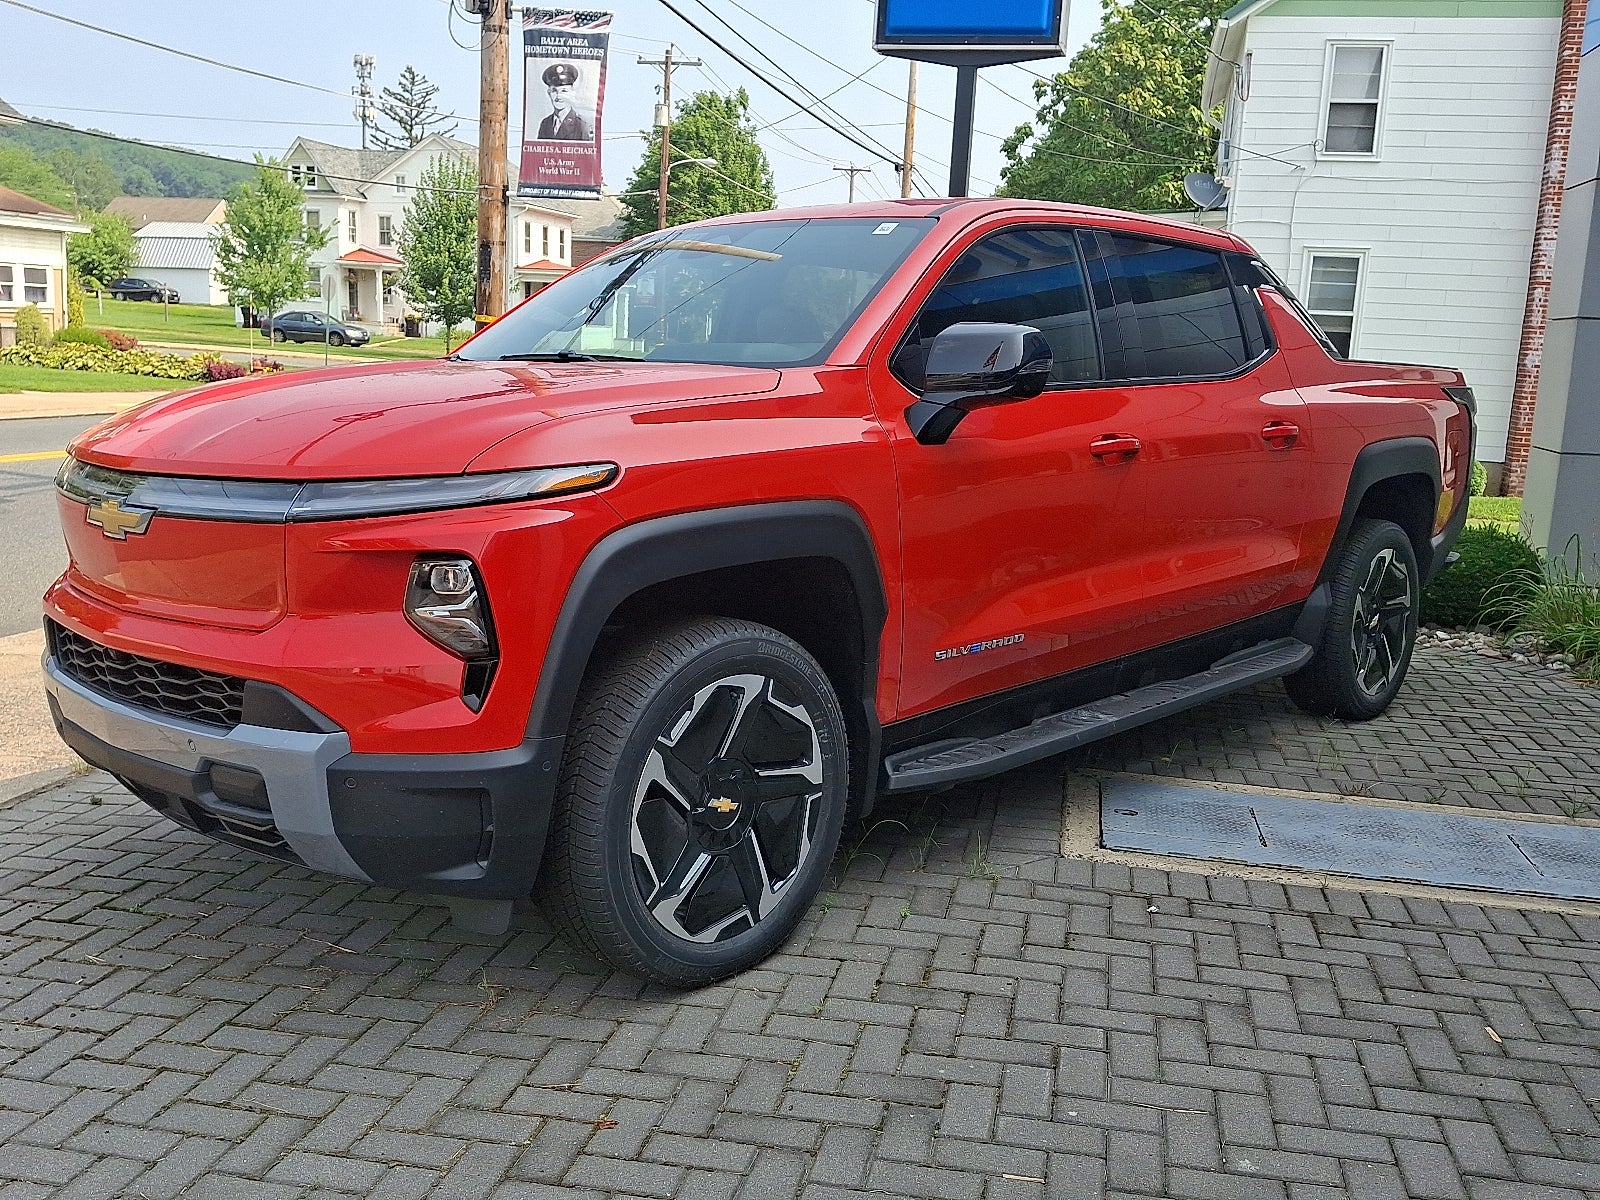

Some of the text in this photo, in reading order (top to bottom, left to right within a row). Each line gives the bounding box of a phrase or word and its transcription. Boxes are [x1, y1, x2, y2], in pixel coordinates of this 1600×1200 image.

[540, 36, 589, 47] BALLY AREA
[524, 44, 605, 57] HOMETOWN HEROES
[522, 145, 554, 153] CHARLES
[562, 146, 598, 155] REICHART
[543, 157, 575, 167] U.S. Army
[538, 166, 580, 176] World War II
[1194, 180, 1213, 190] dish
[934, 633, 1025, 661] SILVERADO
[757, 641, 813, 678] BRIDGESTONE
